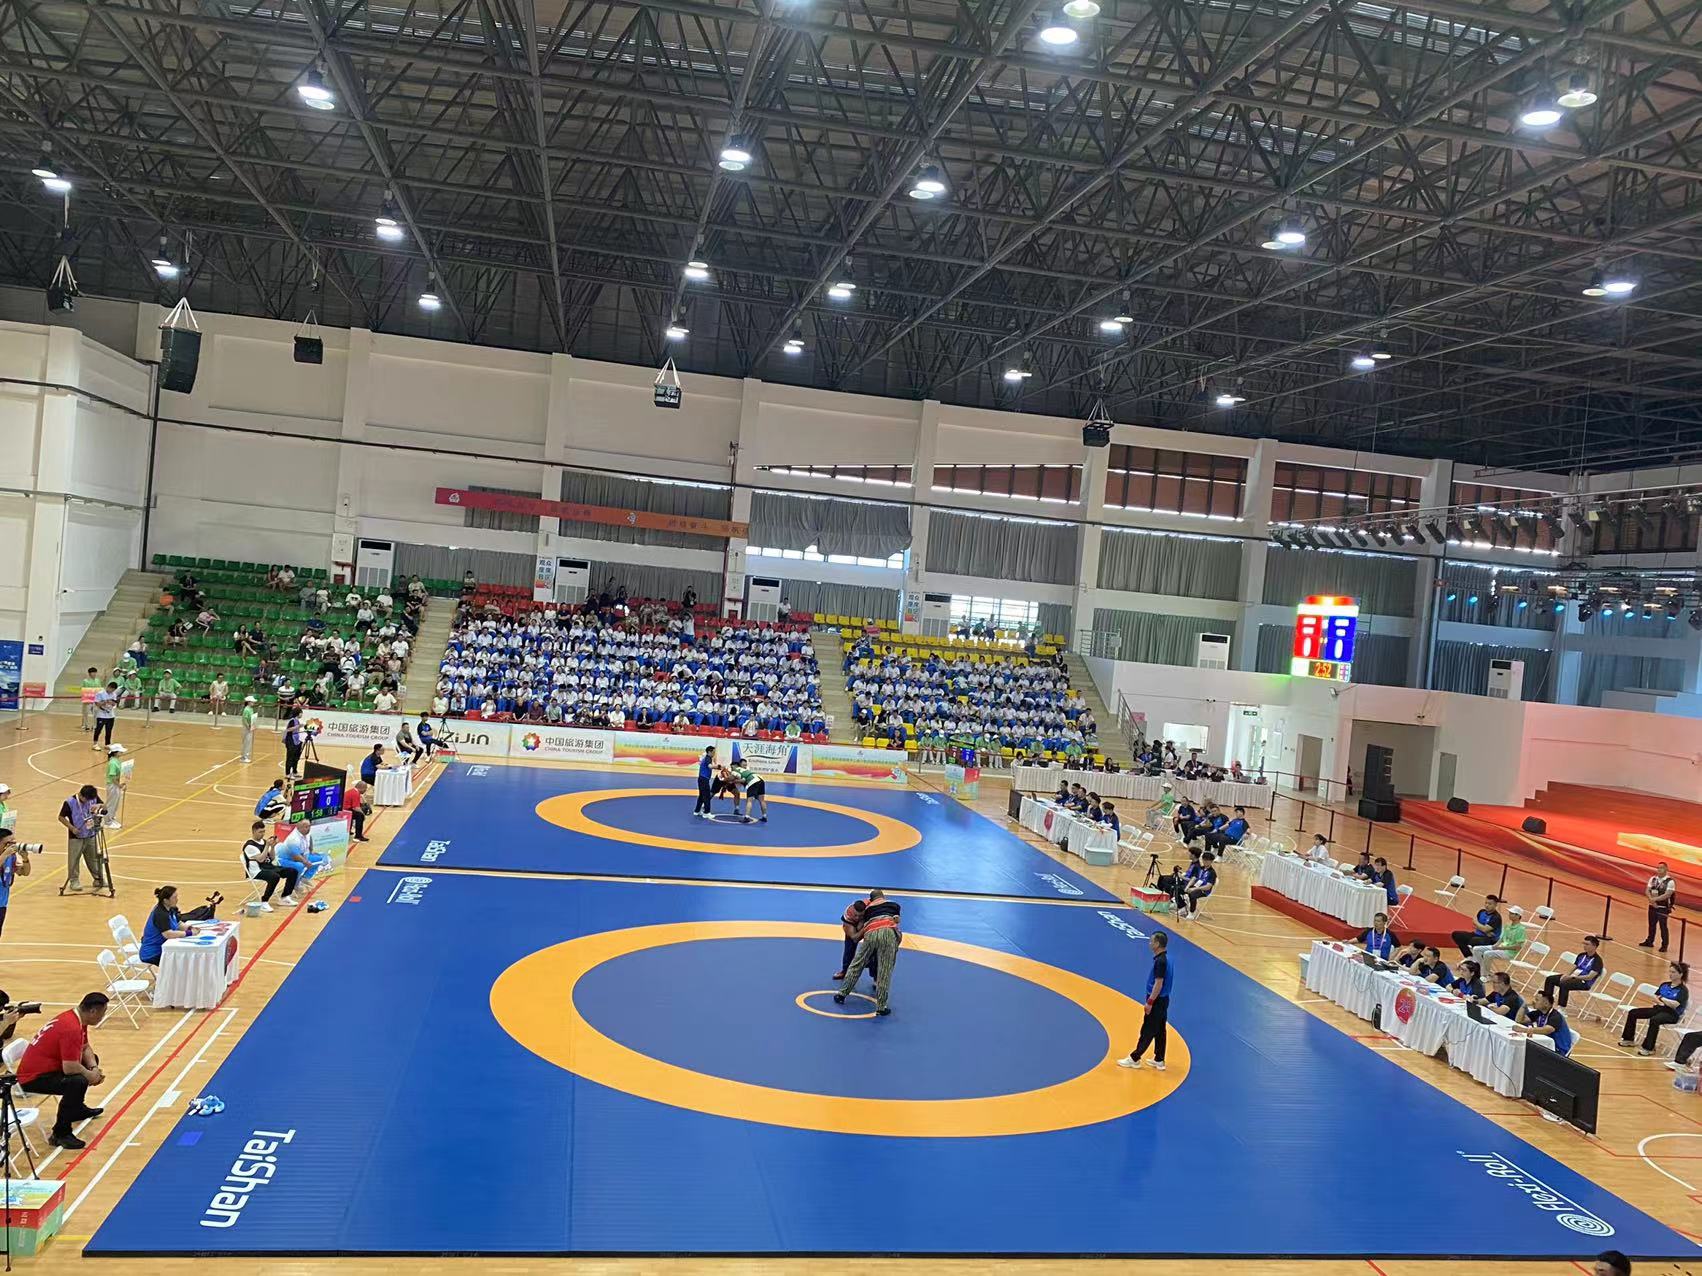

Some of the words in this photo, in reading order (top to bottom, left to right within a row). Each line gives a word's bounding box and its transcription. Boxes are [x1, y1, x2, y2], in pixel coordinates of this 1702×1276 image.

[328, 722, 391, 735] 中国旅游集团
[545, 737, 604, 750] 中国旅游集团
[743, 742, 788, 757] 天涯海角
[200, 1129, 296, 1228] TaiShan
